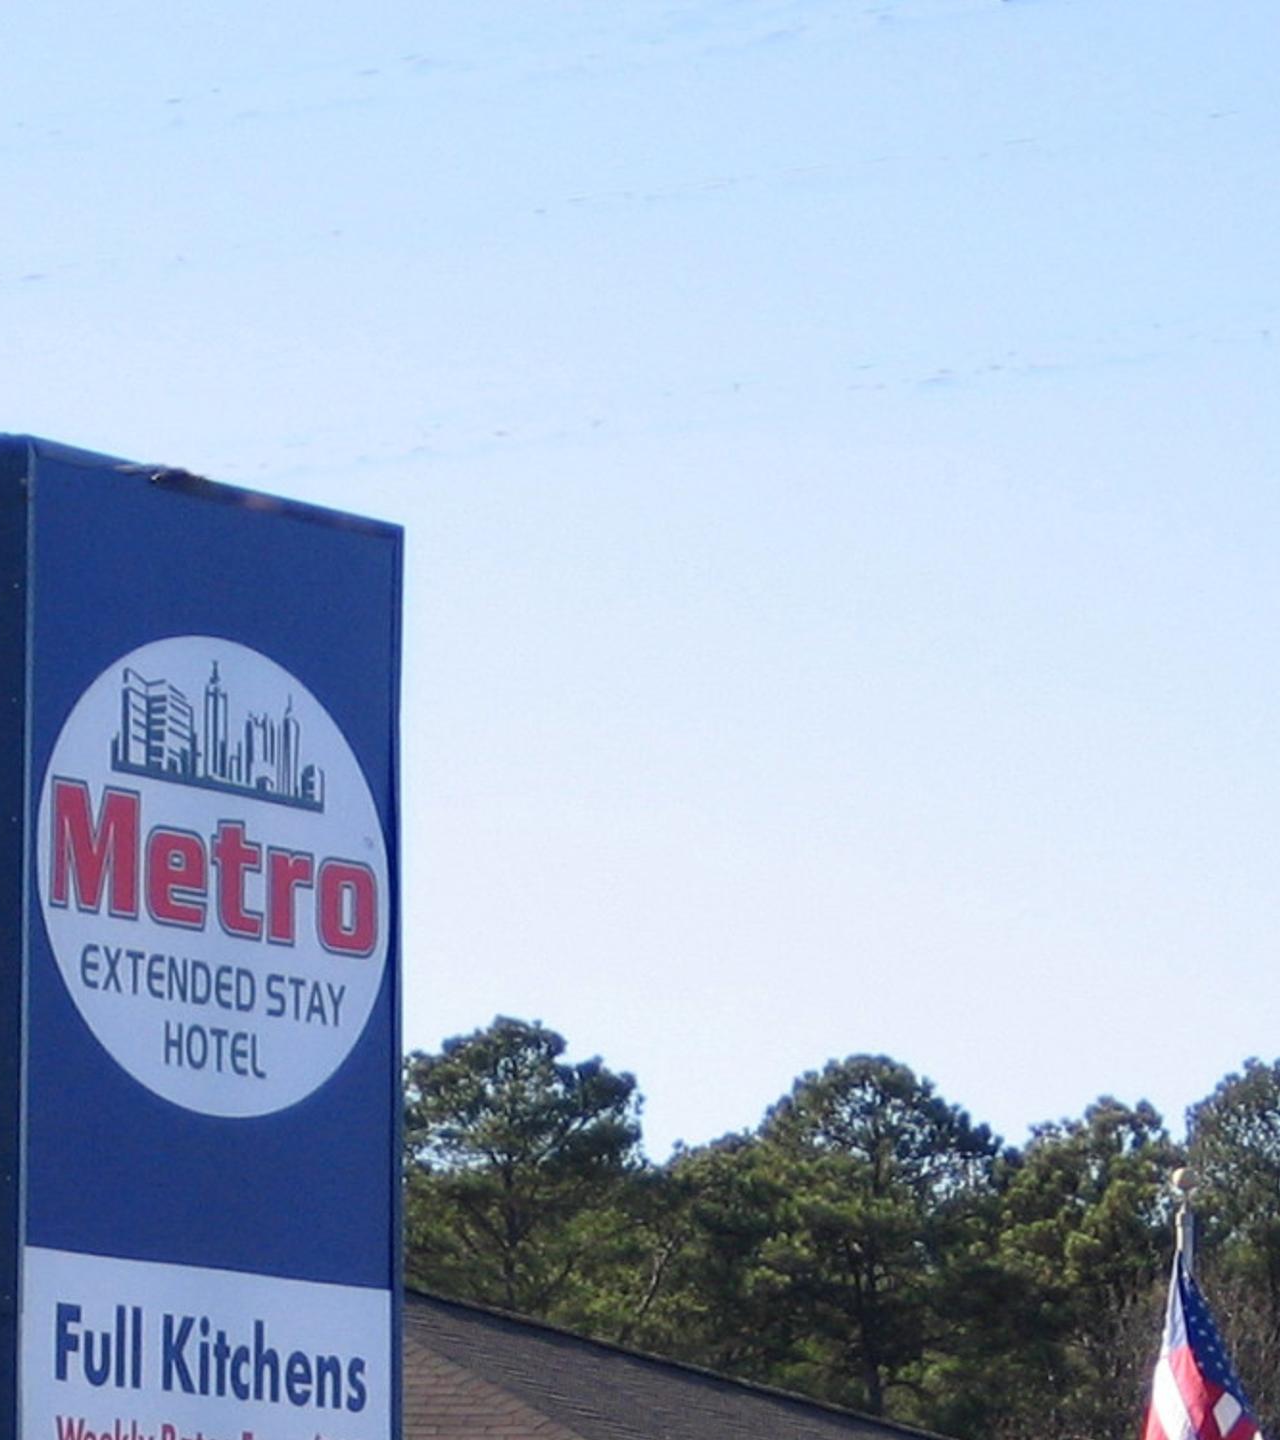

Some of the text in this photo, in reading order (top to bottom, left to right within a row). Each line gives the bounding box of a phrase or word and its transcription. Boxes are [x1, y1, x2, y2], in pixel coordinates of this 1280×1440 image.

[49, 774, 380, 960] Metro
[80, 943, 347, 1028] EXTENDED STAY
[164, 1020, 267, 1079] HOTEL
[55, 1302, 367, 1413] Full Kitchens
